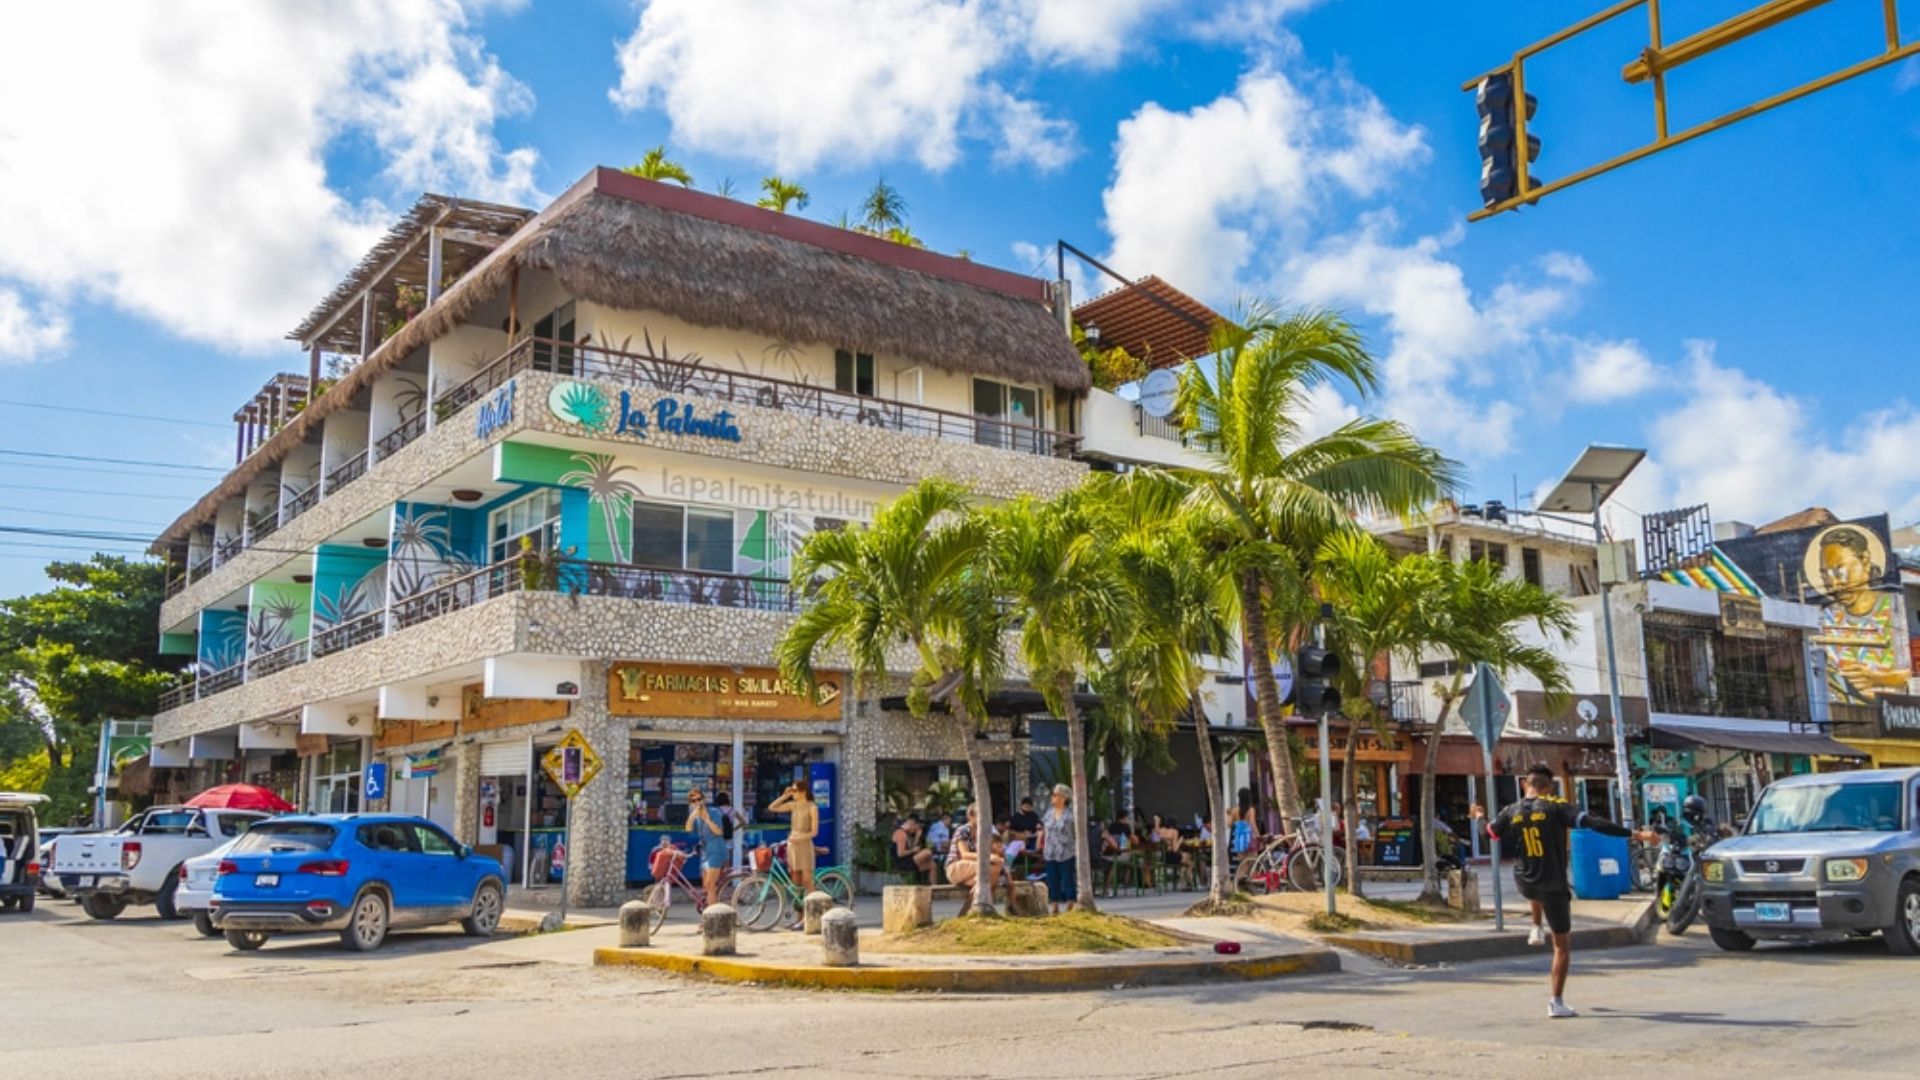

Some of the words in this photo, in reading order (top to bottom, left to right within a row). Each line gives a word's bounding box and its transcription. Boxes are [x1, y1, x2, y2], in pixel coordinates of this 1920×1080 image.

[614, 389, 648, 438] La
[651, 398, 742, 443] Palmita
[645, 673, 729, 694] FARMACIAS
[738, 677, 808, 697] SIMILARES
[1522, 827, 1544, 857] 16
